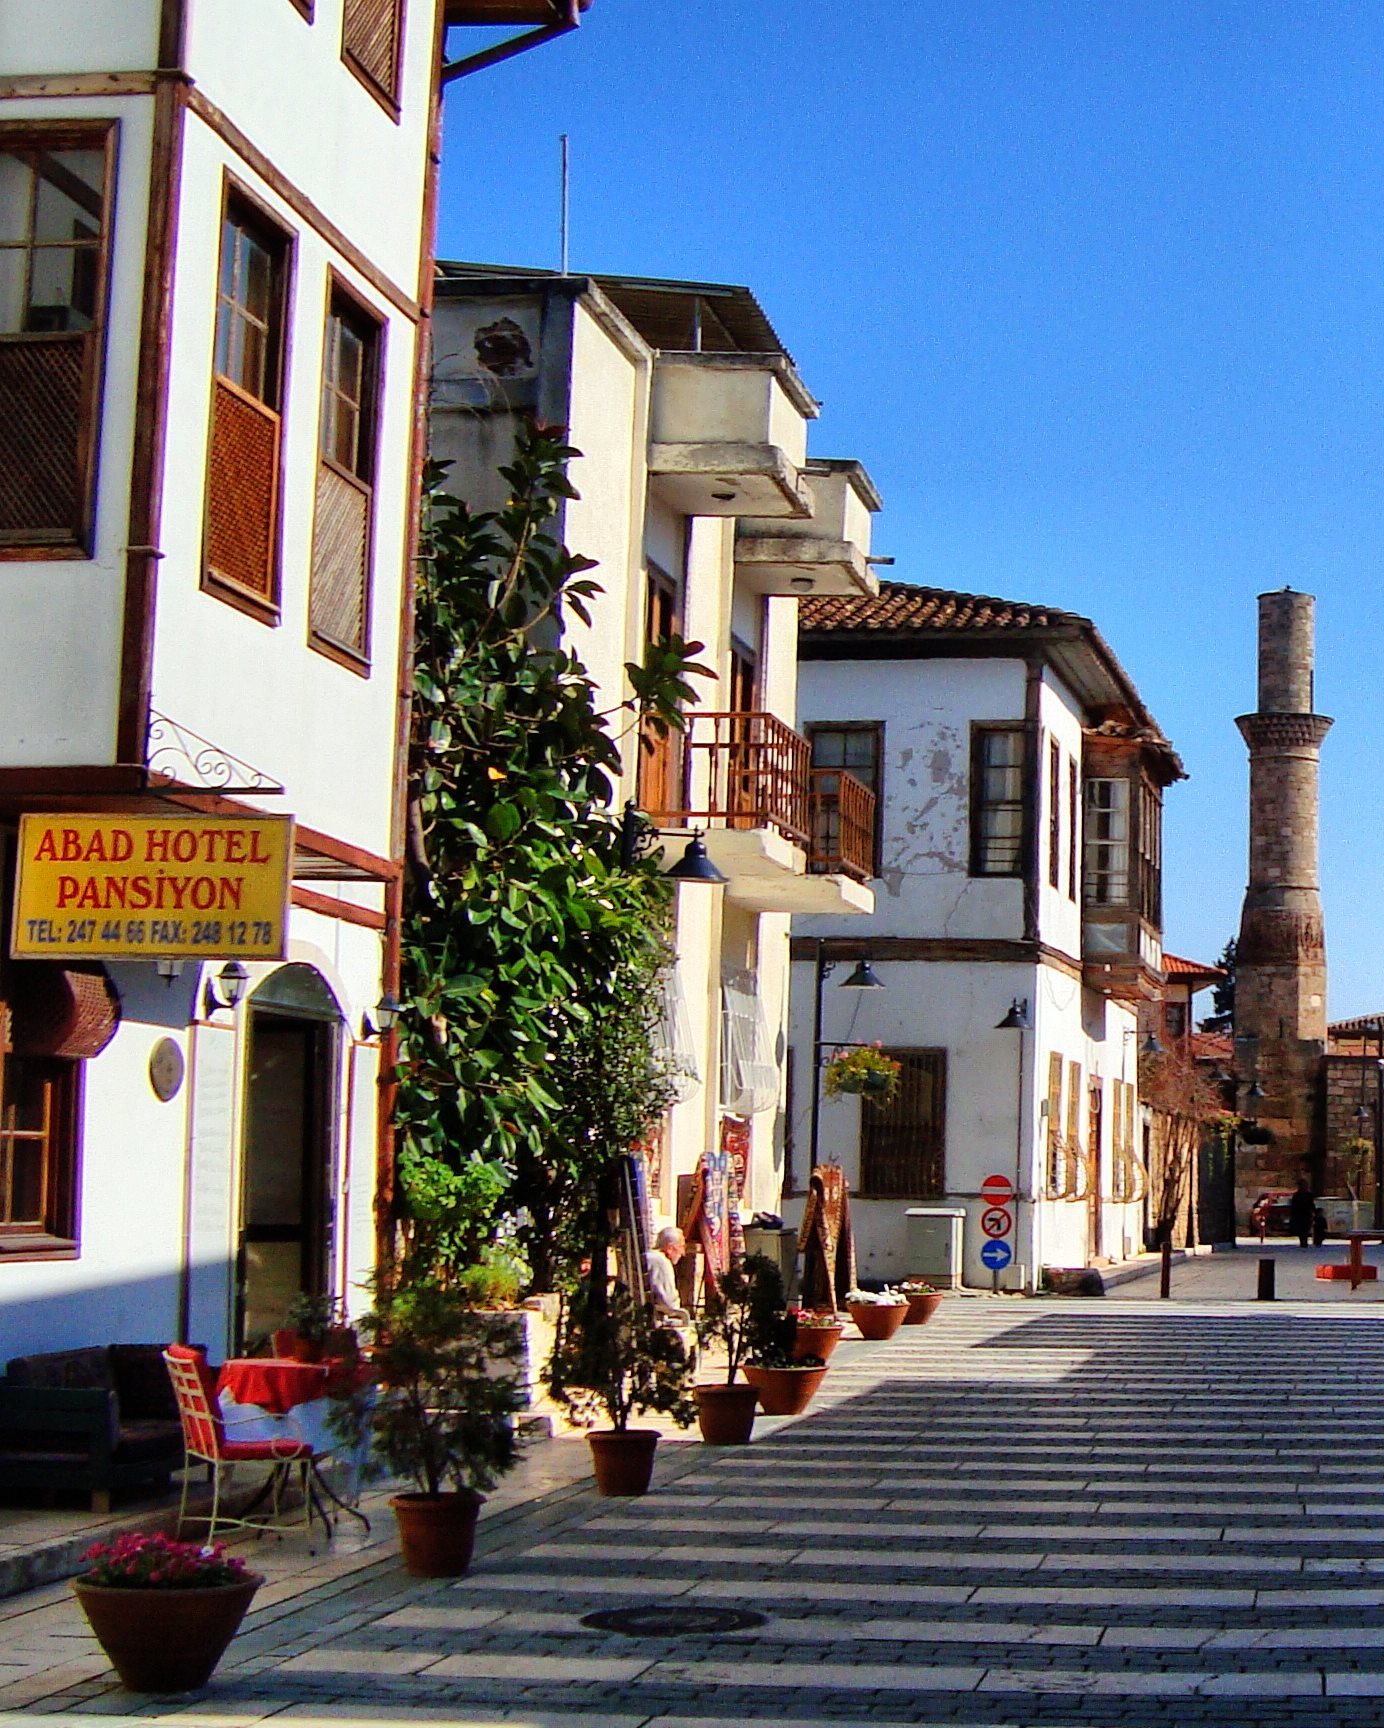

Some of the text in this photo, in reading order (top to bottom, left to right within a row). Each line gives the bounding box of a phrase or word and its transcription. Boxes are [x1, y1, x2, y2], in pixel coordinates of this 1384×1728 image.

[34, 828, 271, 864] ABAD HOTEL
[55, 868, 245, 910] PANSİYON
[27, 919, 62, 944] TEL:
[66, 919, 97, 943] 247
[101, 919, 122, 943] 44
[151, 920, 187, 944] FAX:
[228, 921, 248, 945] 12
[253, 921, 272, 945] 78
